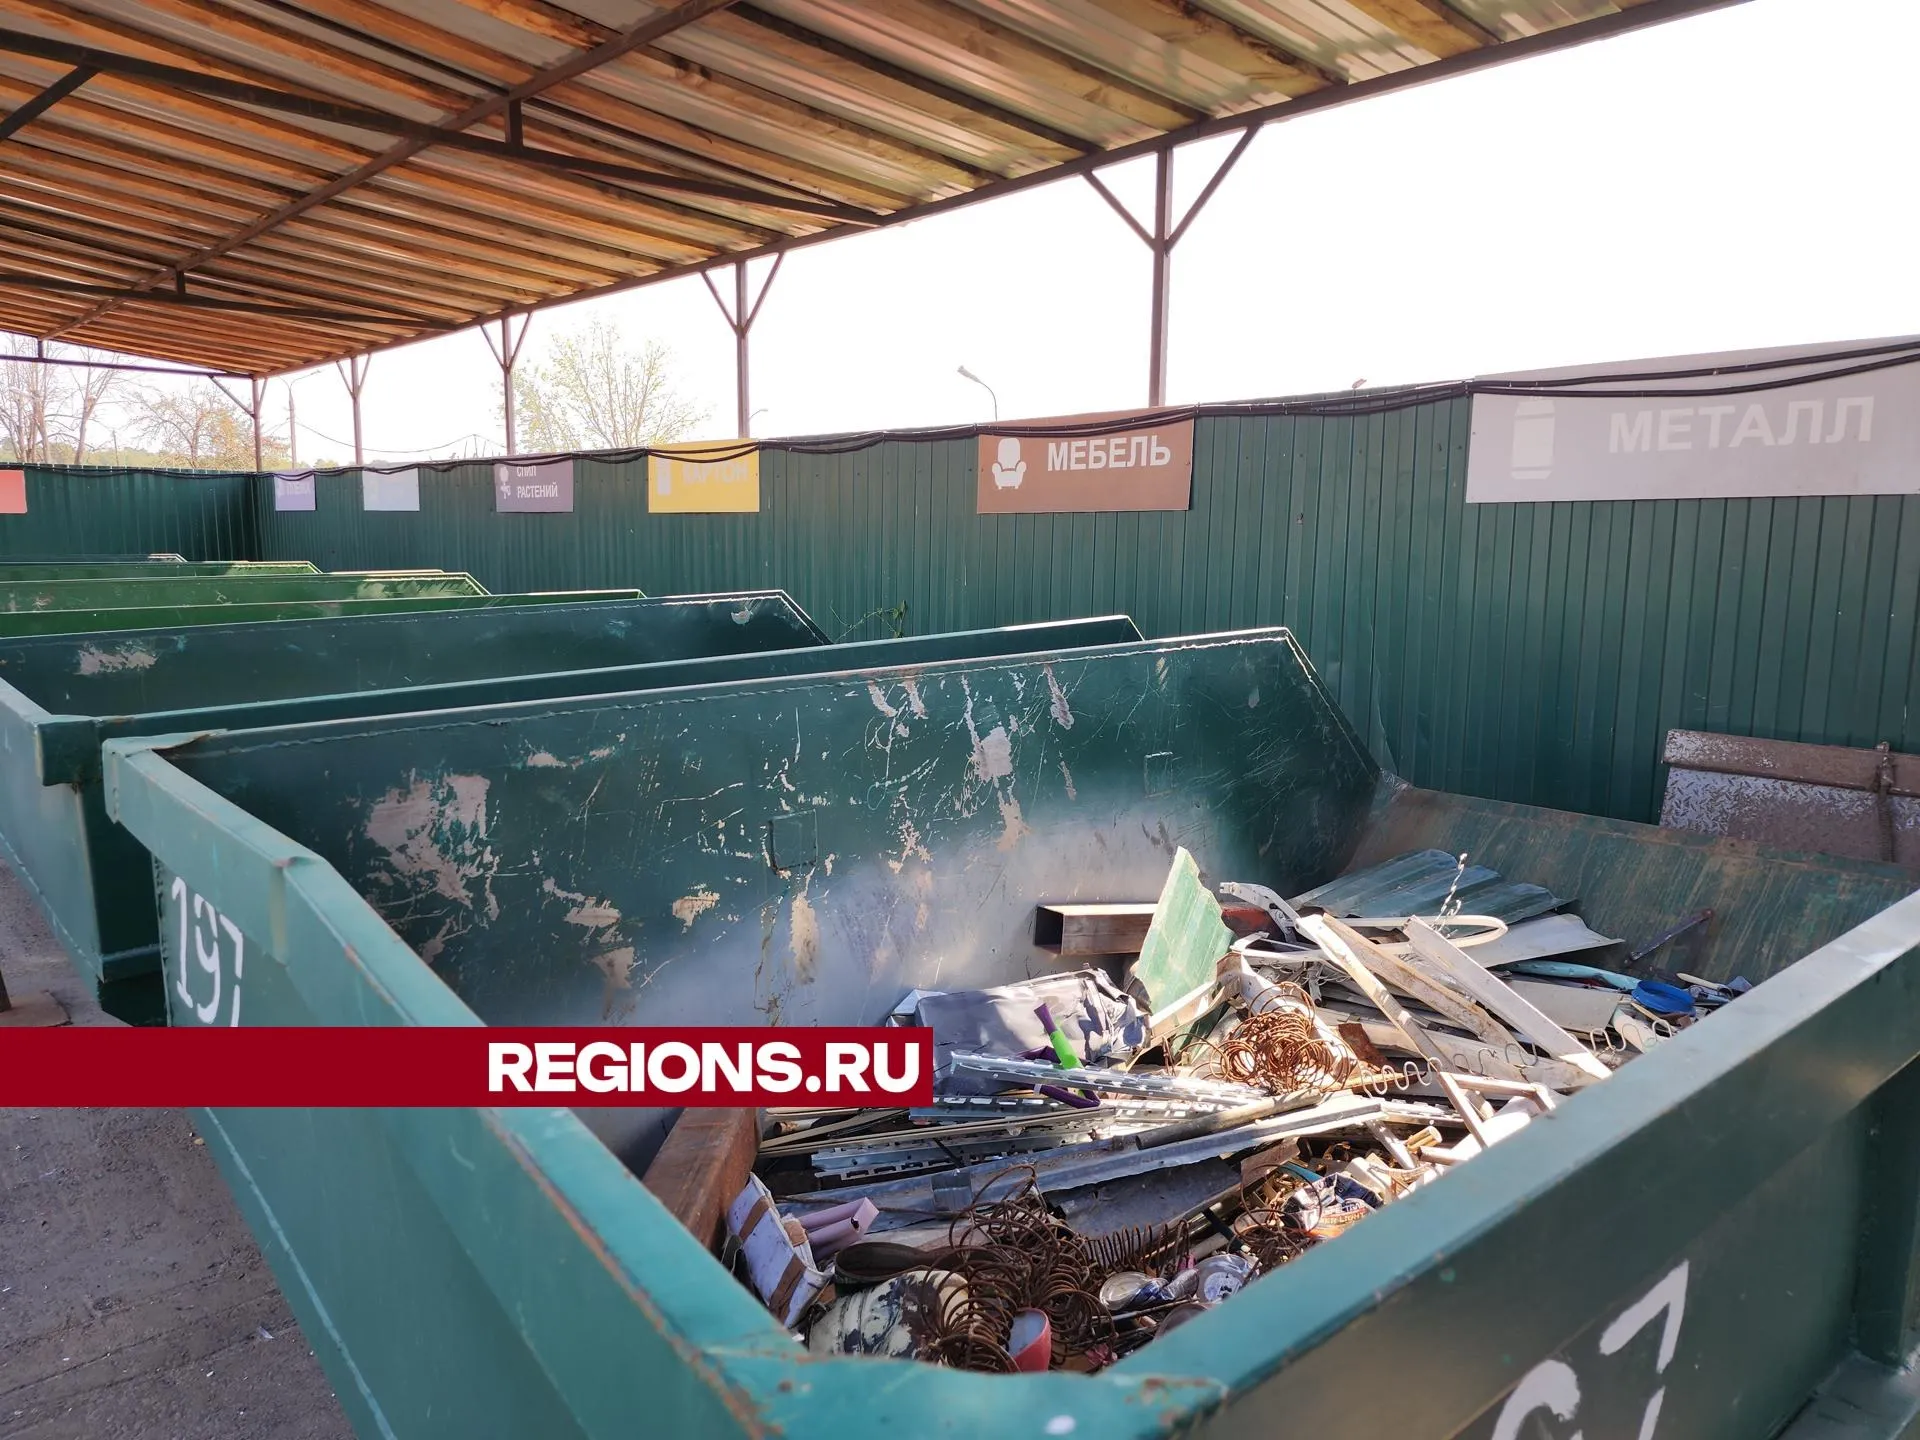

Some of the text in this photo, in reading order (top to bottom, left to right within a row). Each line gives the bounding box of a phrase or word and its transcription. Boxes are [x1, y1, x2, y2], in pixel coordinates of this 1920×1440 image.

[1608, 396, 1875, 454] МЕТАЛЛ
[1047, 434, 1171, 472] МЕБЕЛЬ
[516, 482, 558, 499] РАСТЕНИЙ
[172, 876, 244, 1027] 197
